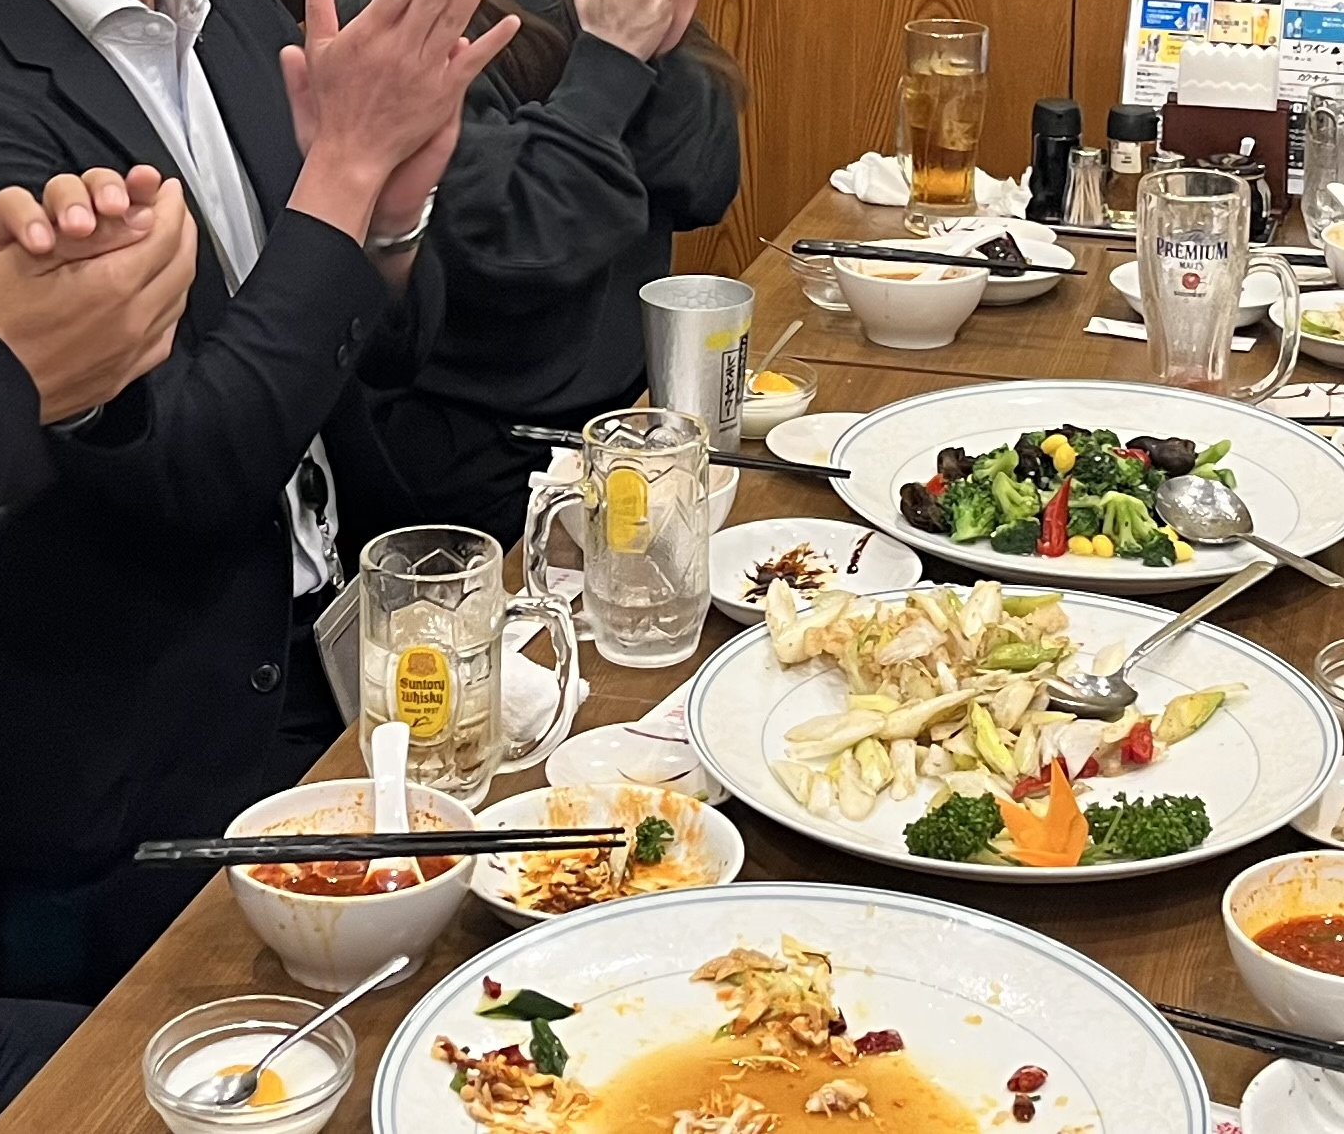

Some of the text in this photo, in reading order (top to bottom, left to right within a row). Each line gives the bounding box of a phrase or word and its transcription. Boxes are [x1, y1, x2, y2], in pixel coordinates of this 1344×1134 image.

[1304, 44, 1330, 53] ワイン
[1297, 73, 1330, 83] カクテル
[1156, 236, 1229, 261] PREMIUM
[399, 677, 445, 692] Suntory
[401, 691, 444, 705] Whisky
